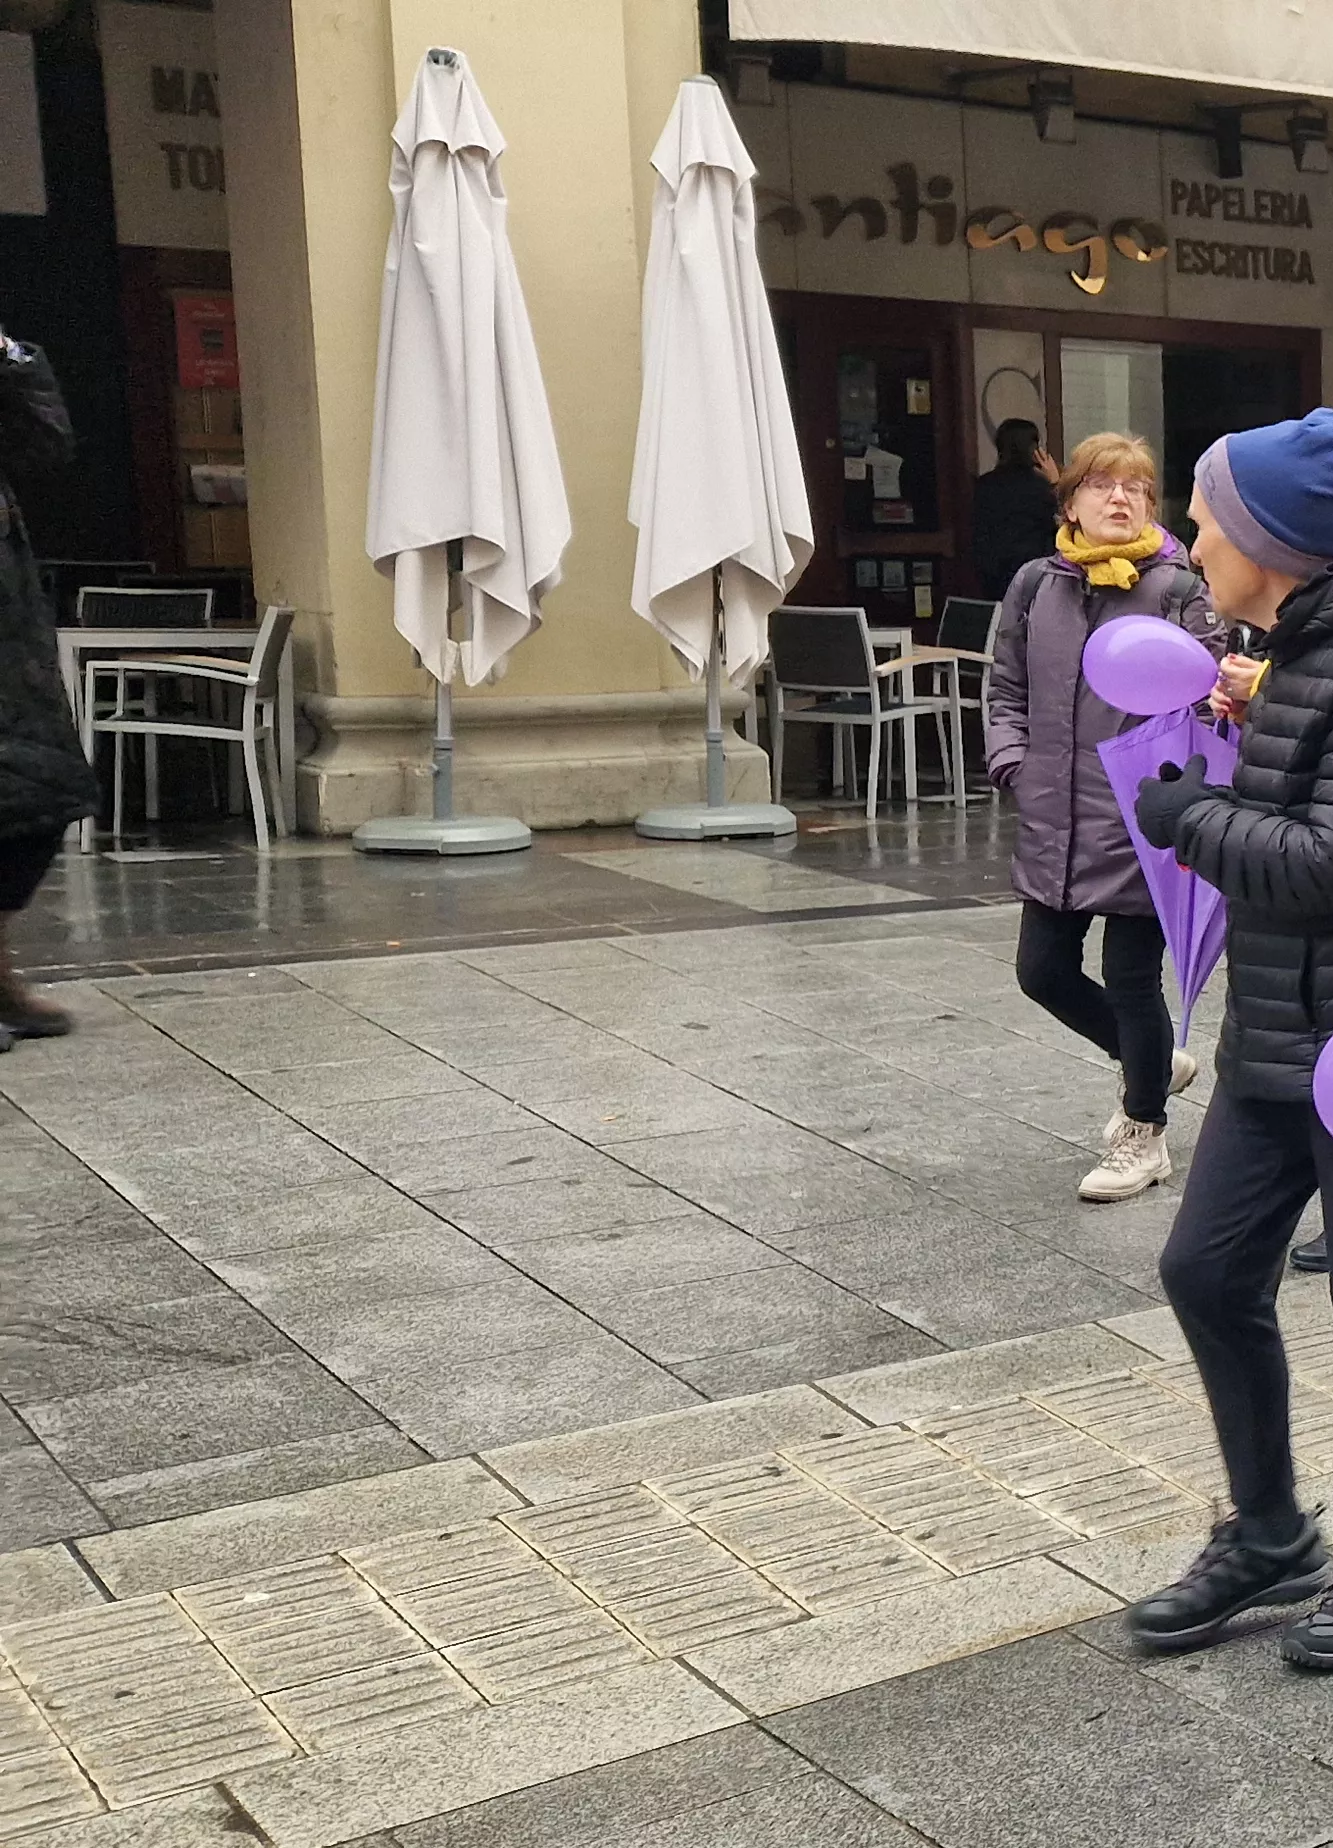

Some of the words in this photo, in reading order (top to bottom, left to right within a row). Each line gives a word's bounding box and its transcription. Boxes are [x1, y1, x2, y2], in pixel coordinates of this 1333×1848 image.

[152, 66, 220, 118] MA
[757, 162, 1169, 295] antiago
[1170, 178, 1314, 229] PAPELERIA
[1175, 238, 1316, 285] ESCRITURA
